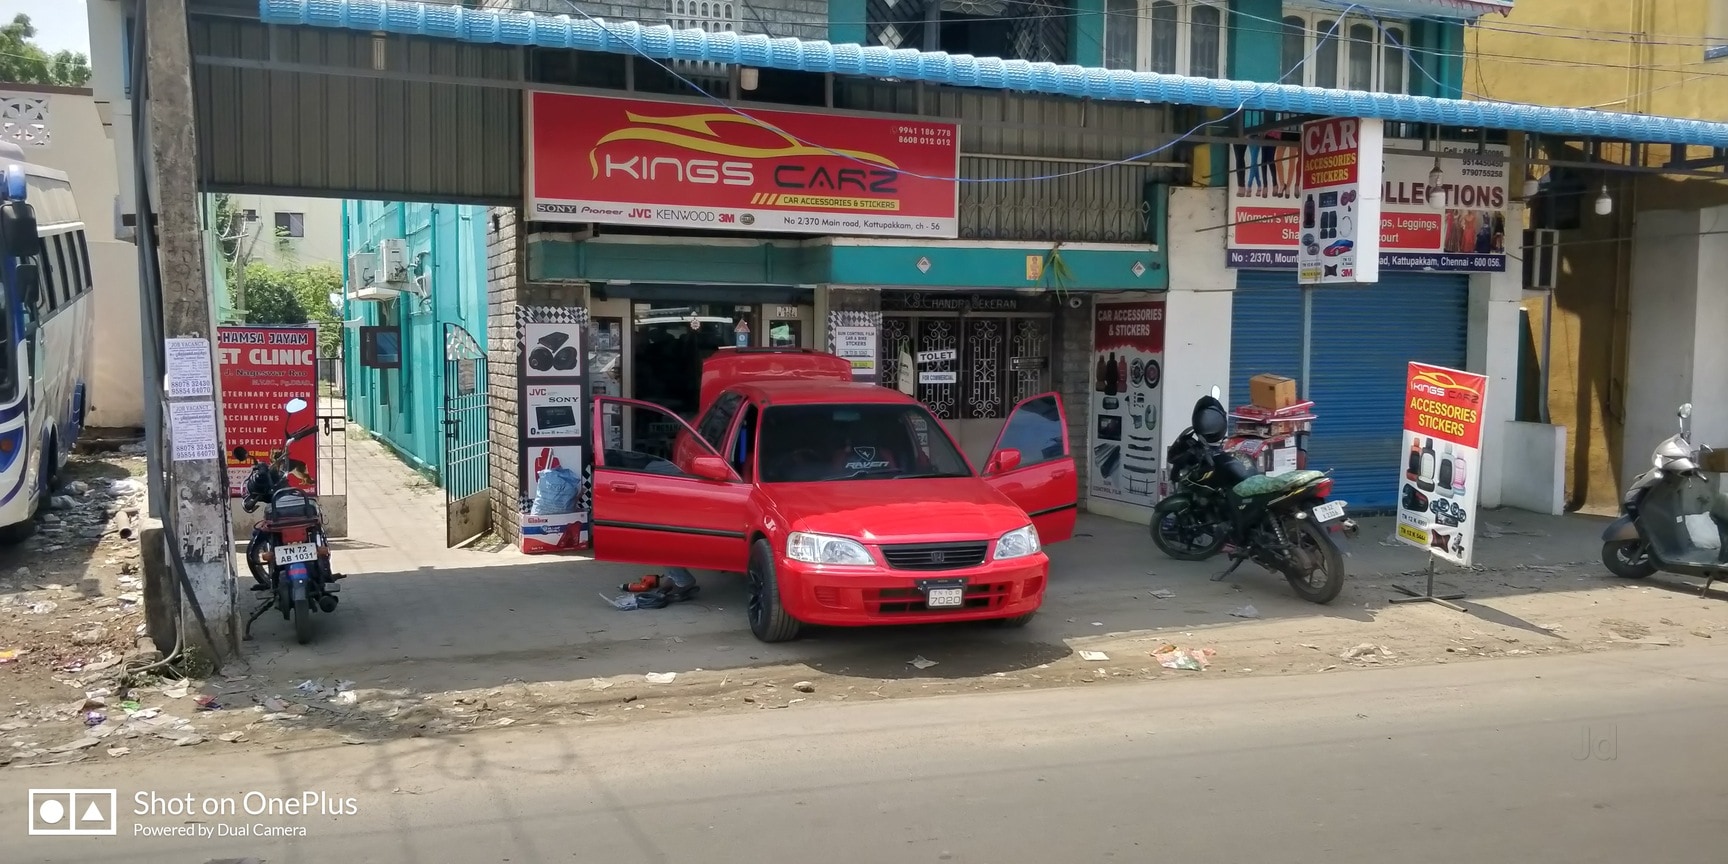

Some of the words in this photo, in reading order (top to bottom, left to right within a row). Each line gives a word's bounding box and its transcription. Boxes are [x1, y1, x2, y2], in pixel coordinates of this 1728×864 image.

[899, 126, 917, 135] 9941
[921, 128, 934, 136] 186
[937, 129, 951, 137] 778
[1305, 120, 1357, 155] CAR
[899, 136, 917, 144] 8608
[920, 137, 934, 145] 012
[937, 138, 951, 146] 012
[1305, 153, 1356, 171] ACCESSORIES
[605, 154, 754, 186] KINGS
[774, 165, 898, 193] CARZ
[1311, 168, 1349, 184] STICKERS
[1462, 169, 1503, 178] 9790755258
[1381, 181, 1504, 208] LLETIONS
[783, 196, 799, 205] CAR
[800, 198, 852, 207] ACCESSORIES
[860, 200, 895, 209] STICKERS
[537, 203, 577, 214] SONY
[581, 206, 623, 216] Pioneer
[628, 209, 651, 219] JVC
[656, 209, 715, 222] KENWOOD
[718, 213, 735, 223] 3M
[784, 217, 795, 225] No
[797, 217, 820, 226] 2/370
[821, 219, 840, 227] Main
[842, 220, 861, 229] road,
[863, 220, 913, 231] Kattupakkam,
[915, 221, 924, 230] ch
[931, 223, 940, 231] 56
[1237, 212, 1281, 224] Women's
[1284, 213, 1299, 224] We
[1379, 219, 1395, 229] ps,
[1397, 218, 1439, 231] Leggings,
[1282, 228, 1299, 240] Sha
[1231, 253, 1243, 262] No
[1250, 253, 1272, 264] 2/370,
[1392, 256, 1439, 267] Kattupakkam,
[1441, 257, 1468, 266] Chennai
[1474, 258, 1486, 267] 600
[1487, 258, 1501, 267] 056.
[1341, 269, 1353, 277] 3M
[1097, 310, 1112, 321] CAR
[1113, 308, 1162, 321] ACCESSORIES
[1108, 324, 1114, 336] &
[1115, 324, 1150, 336] STICKERS
[269, 332, 308, 344] JAYAM
[219, 348, 241, 364] ET
[249, 348, 313, 365] CLINIC
[920, 351, 953, 360] TOLET
[529, 388, 547, 396] JVC
[1413, 383, 1445, 396] KINGS
[1448, 390, 1479, 404] CARZ
[1410, 397, 1477, 423] ACCESSORIES
[1418, 413, 1465, 437] STICKERS
[284, 547, 295, 555] TN
[298, 545, 307, 553] 72
[281, 555, 292, 563] AB
[295, 552, 314, 562] 1031
[931, 596, 961, 605] 7020
